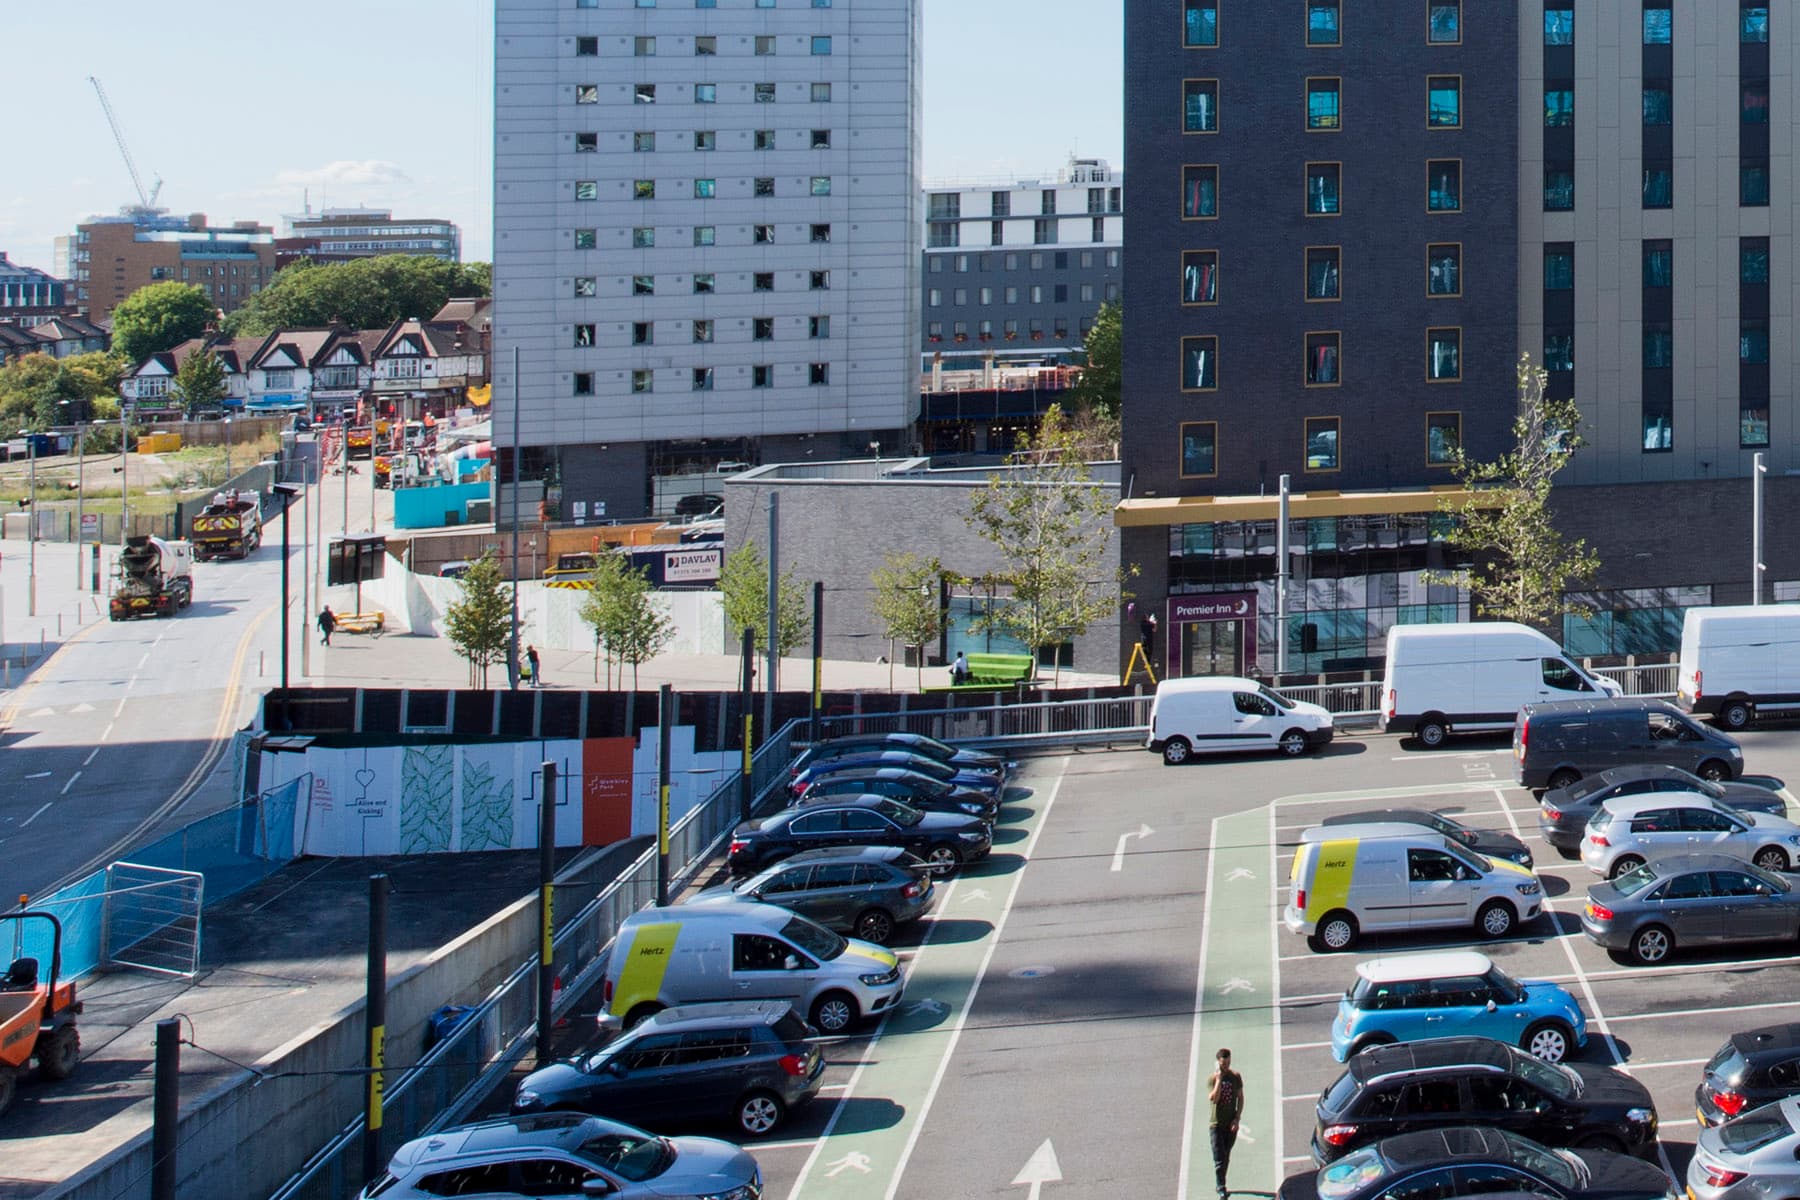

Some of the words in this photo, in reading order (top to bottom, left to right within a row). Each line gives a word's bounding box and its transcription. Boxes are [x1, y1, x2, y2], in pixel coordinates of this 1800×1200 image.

[681, 554, 717, 565] DAVLAV
[1176, 605, 1214, 617] Premier
[1216, 603, 1232, 615] Inn
[1325, 860, 1346, 869] Hertz
[640, 946, 665, 956] Hertz
